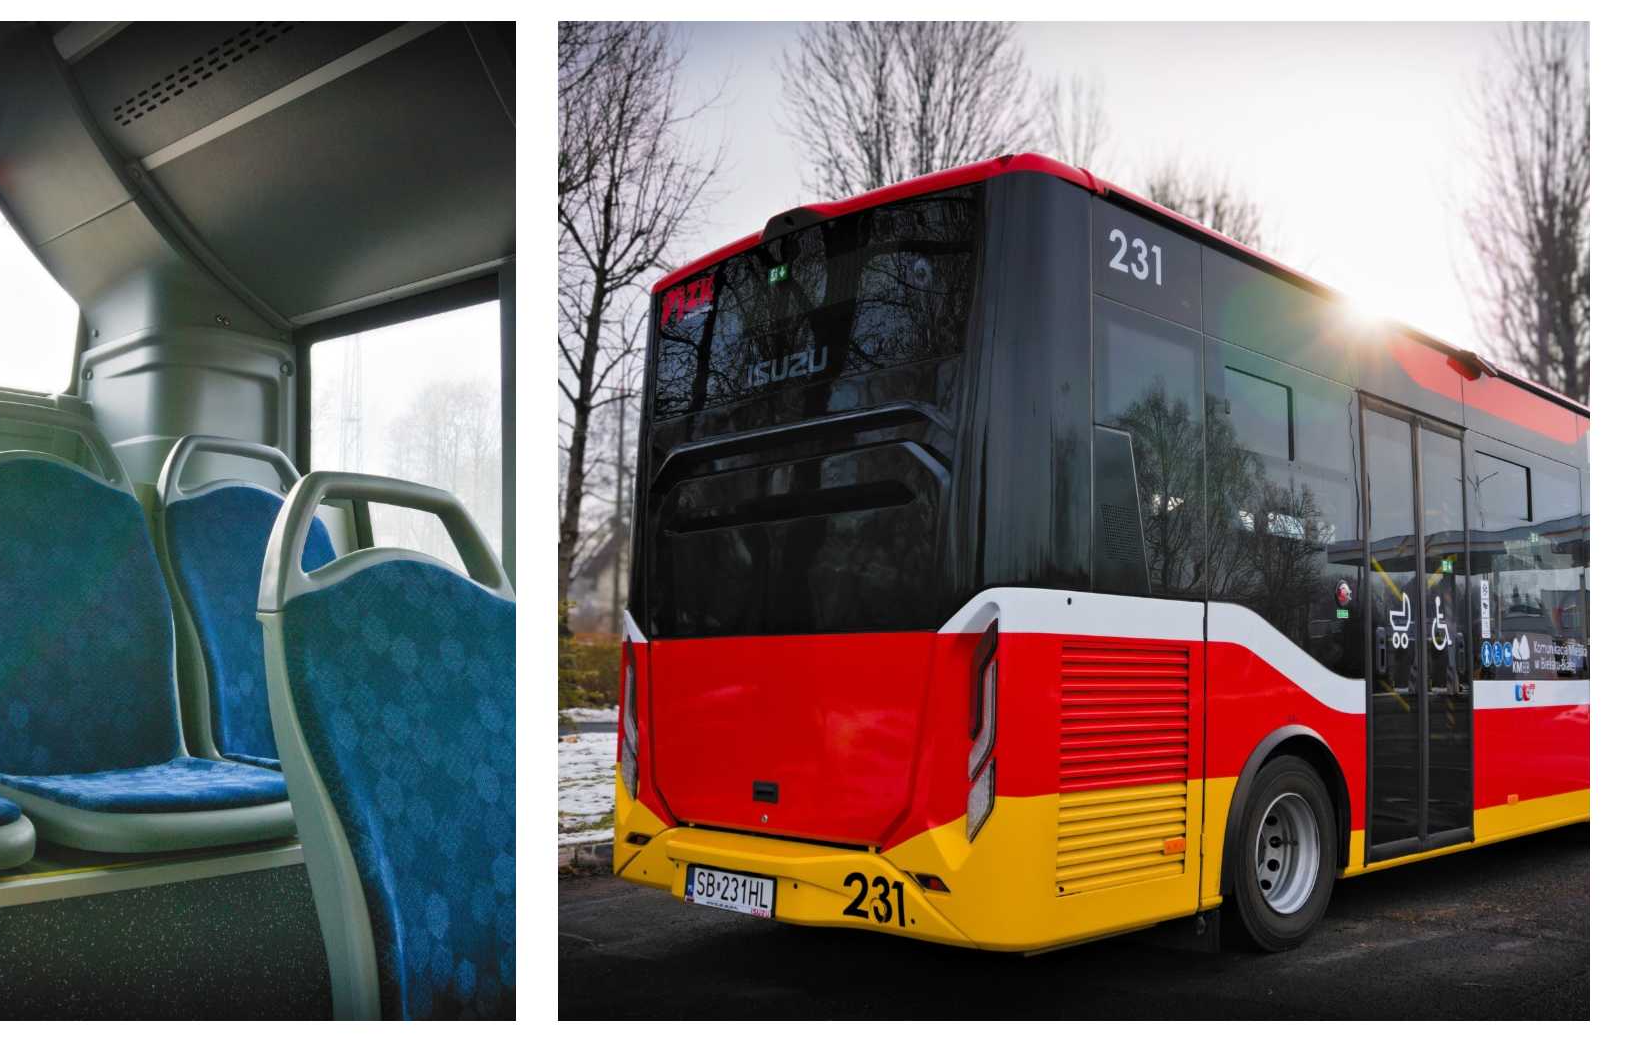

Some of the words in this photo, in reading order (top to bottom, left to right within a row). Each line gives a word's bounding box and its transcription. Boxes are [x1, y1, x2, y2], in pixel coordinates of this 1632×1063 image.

[1109, 228, 1162, 286] 231
[747, 345, 828, 389] ISUZU
[843, 872, 905, 927] 231
